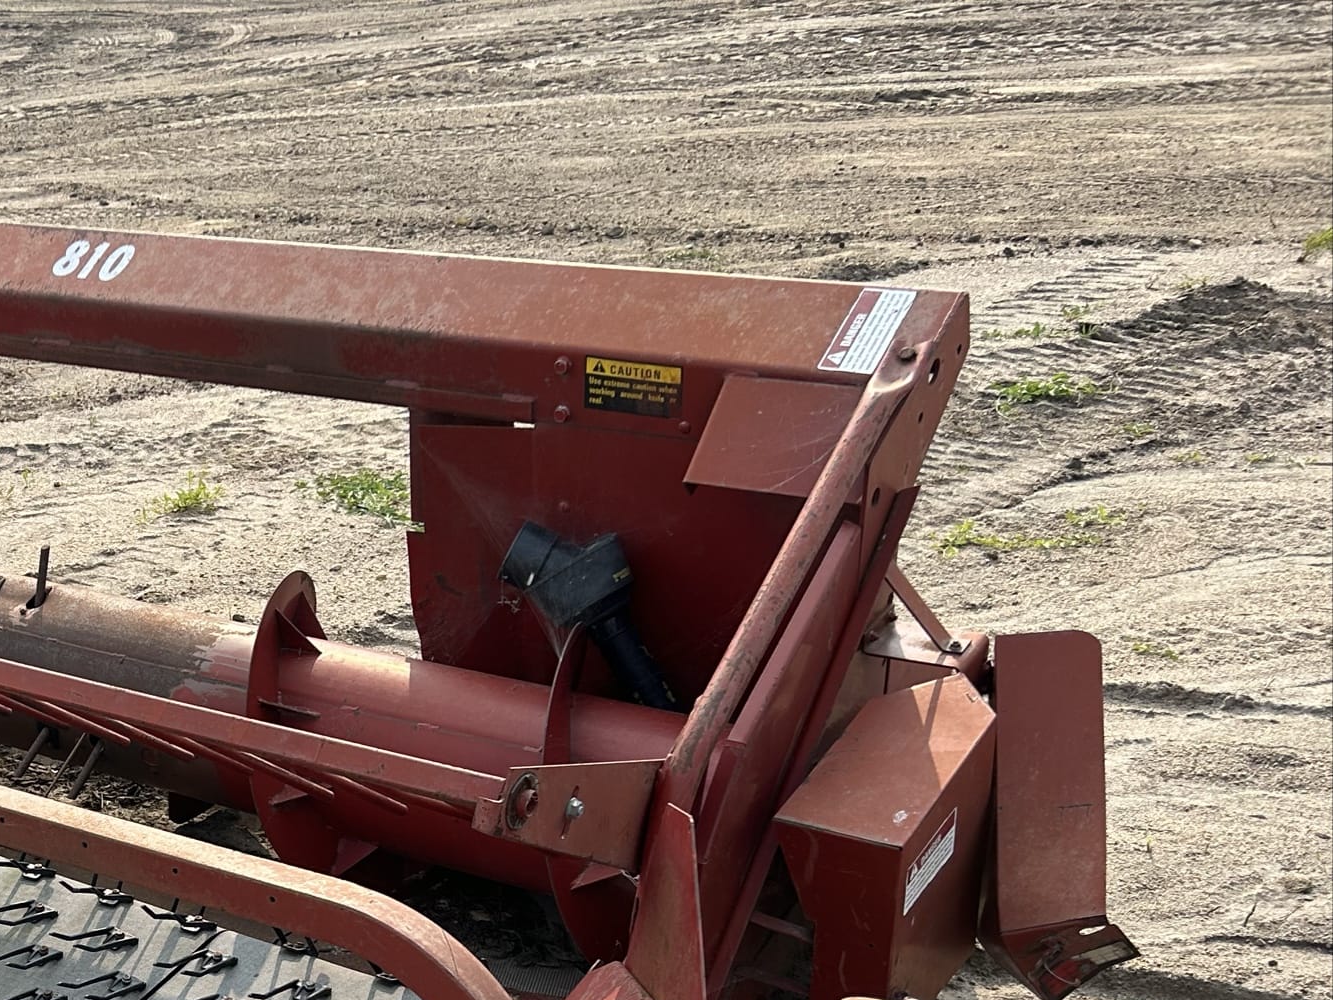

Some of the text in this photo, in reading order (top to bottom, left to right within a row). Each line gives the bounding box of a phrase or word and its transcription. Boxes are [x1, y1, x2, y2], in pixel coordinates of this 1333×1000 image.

[52, 239, 135, 282] 810
[840, 313, 868, 347] DANGER
[610, 365, 661, 380] CAUTION
[588, 376, 601, 385] Use
[603, 379, 630, 389] extreme
[632, 382, 657, 392] caution
[589, 387, 616, 398] working
[620, 391, 643, 400] around
